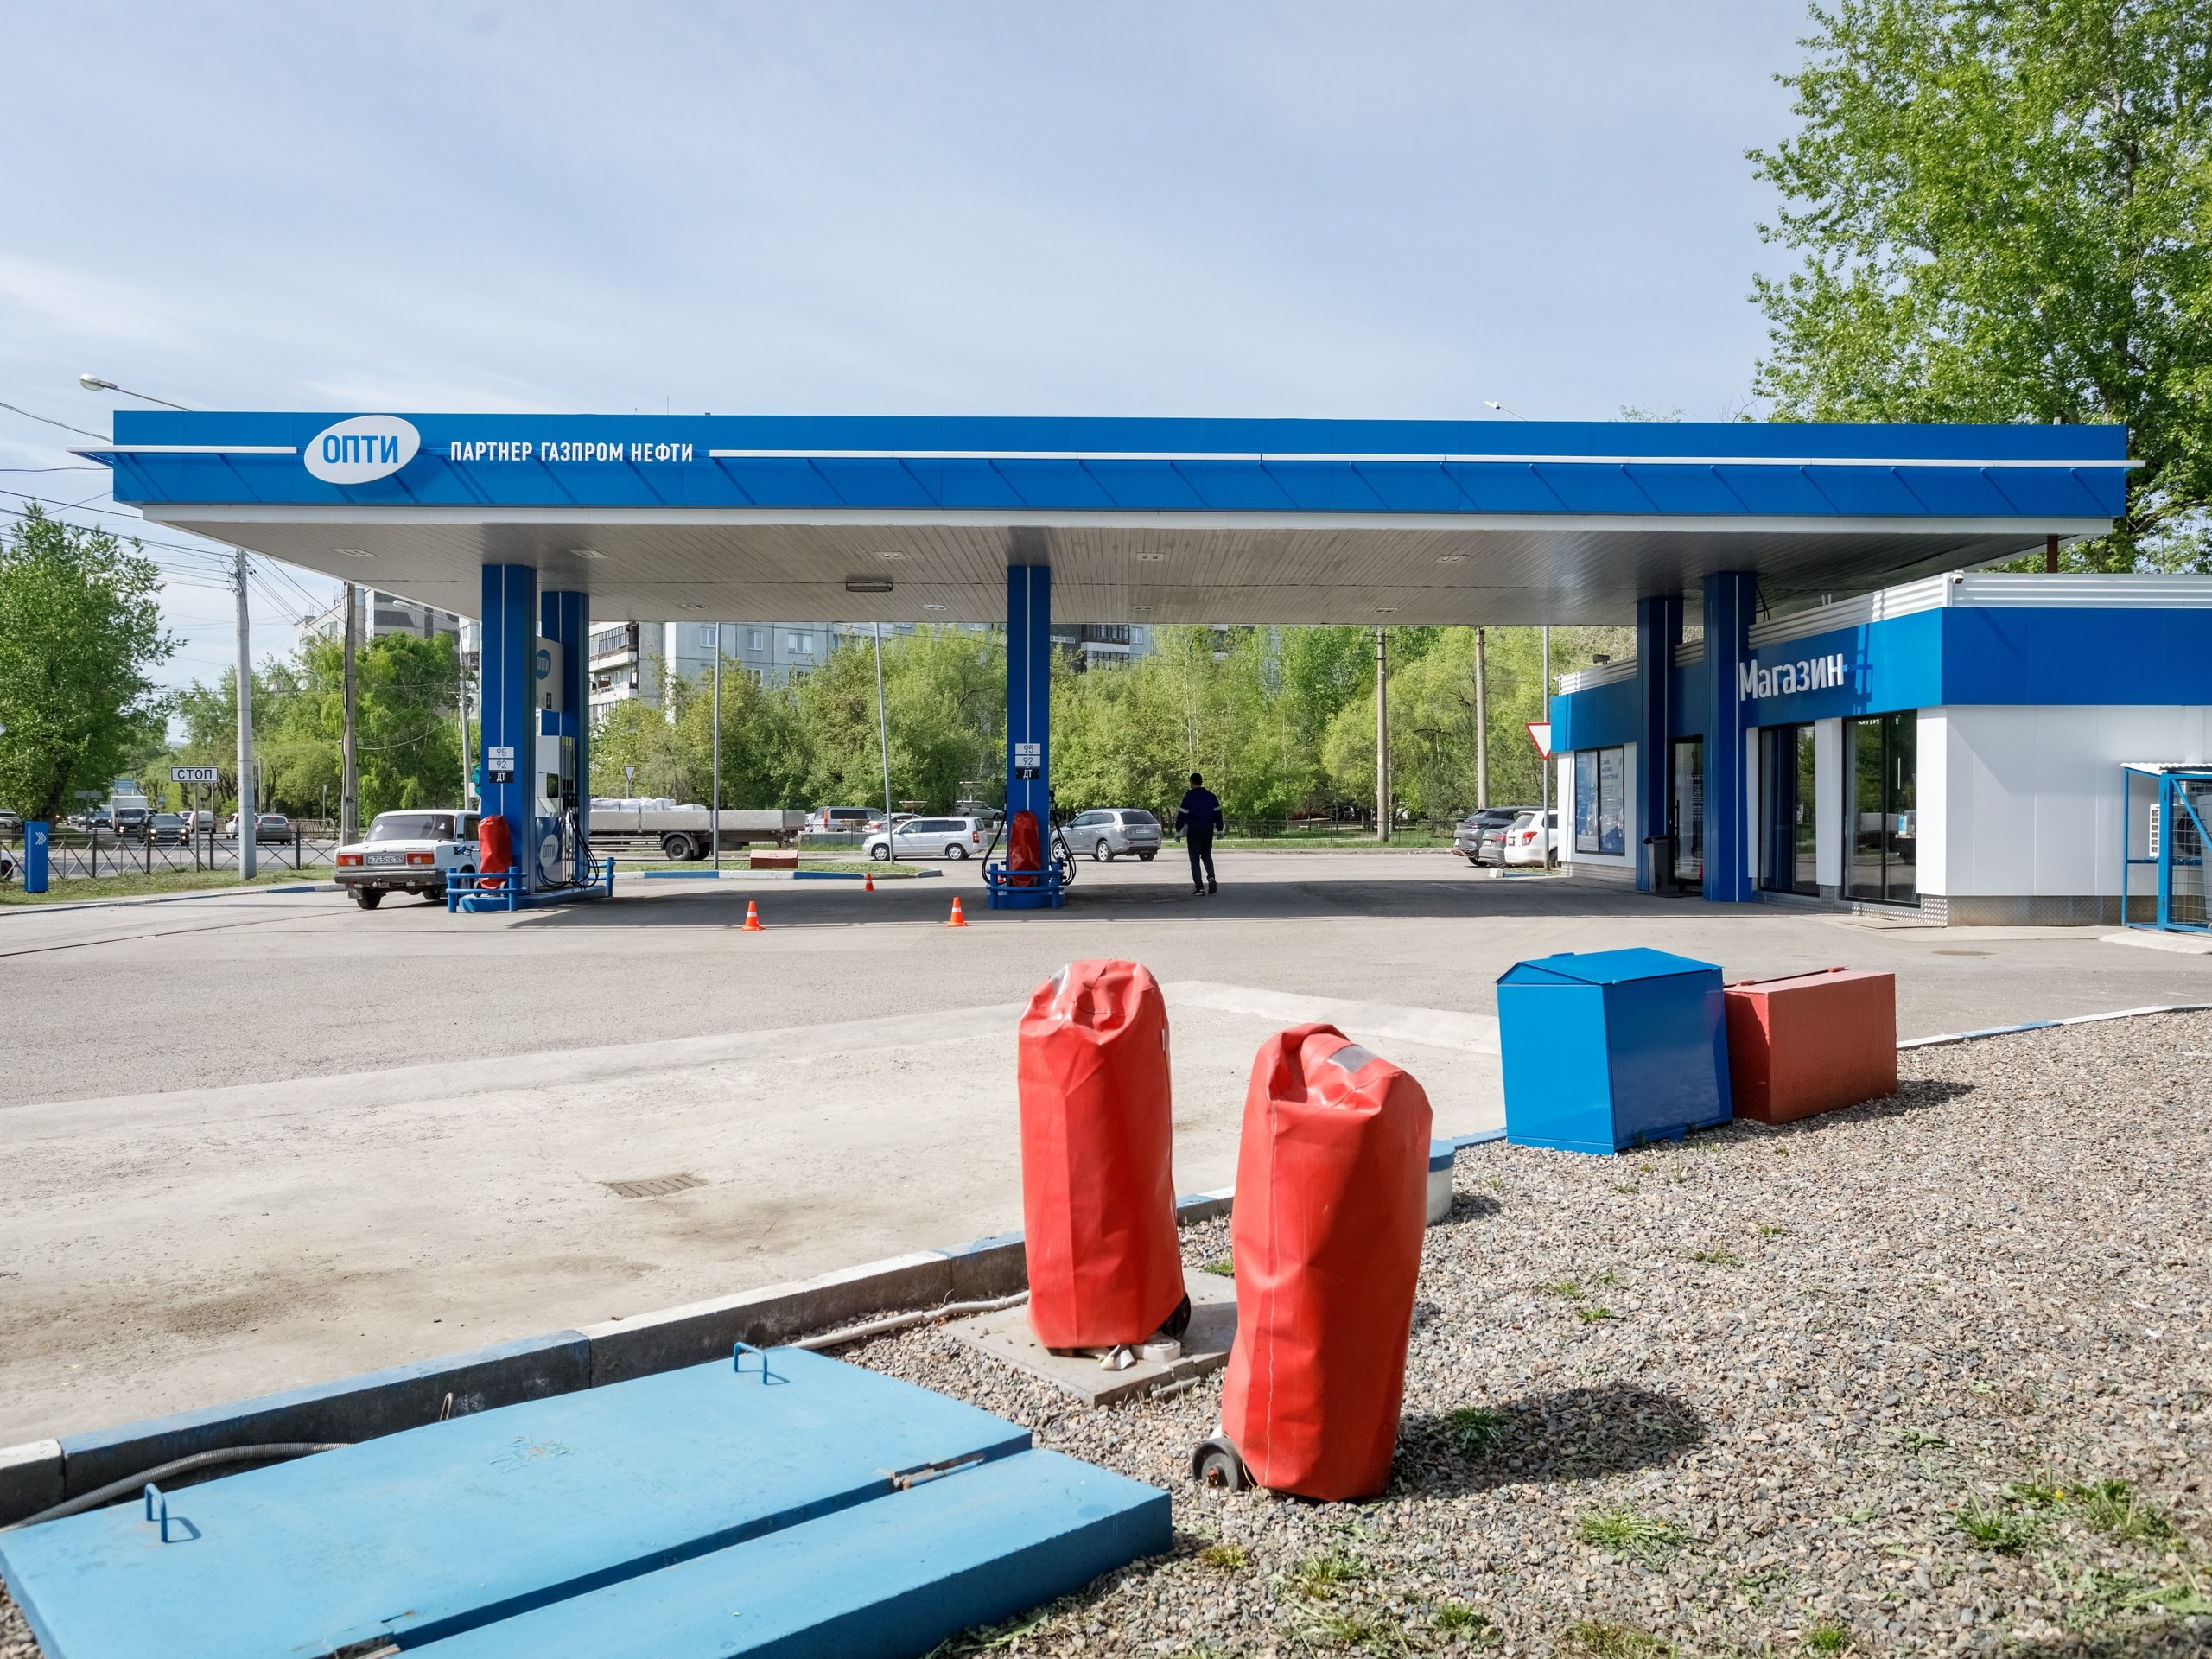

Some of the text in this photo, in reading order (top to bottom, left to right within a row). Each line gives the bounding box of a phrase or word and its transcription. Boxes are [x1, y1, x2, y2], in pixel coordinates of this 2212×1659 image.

[322, 435, 398, 464] ОПТИ
[450, 442, 693, 462] ПАРТНЕР ГАЗПРОМ НЕФТИ
[1739, 653, 1844, 701] Магазин
[496, 748, 507, 757] 95
[1023, 745, 1034, 753] 95
[496, 760, 507, 769] 92
[1022, 757, 1033, 766] 92
[177, 769, 213, 780] СТОП
[496, 772, 506, 782] ДТ
[1022, 769, 1033, 779] ДТ
[543, 843, 556, 858] ОПТИ
